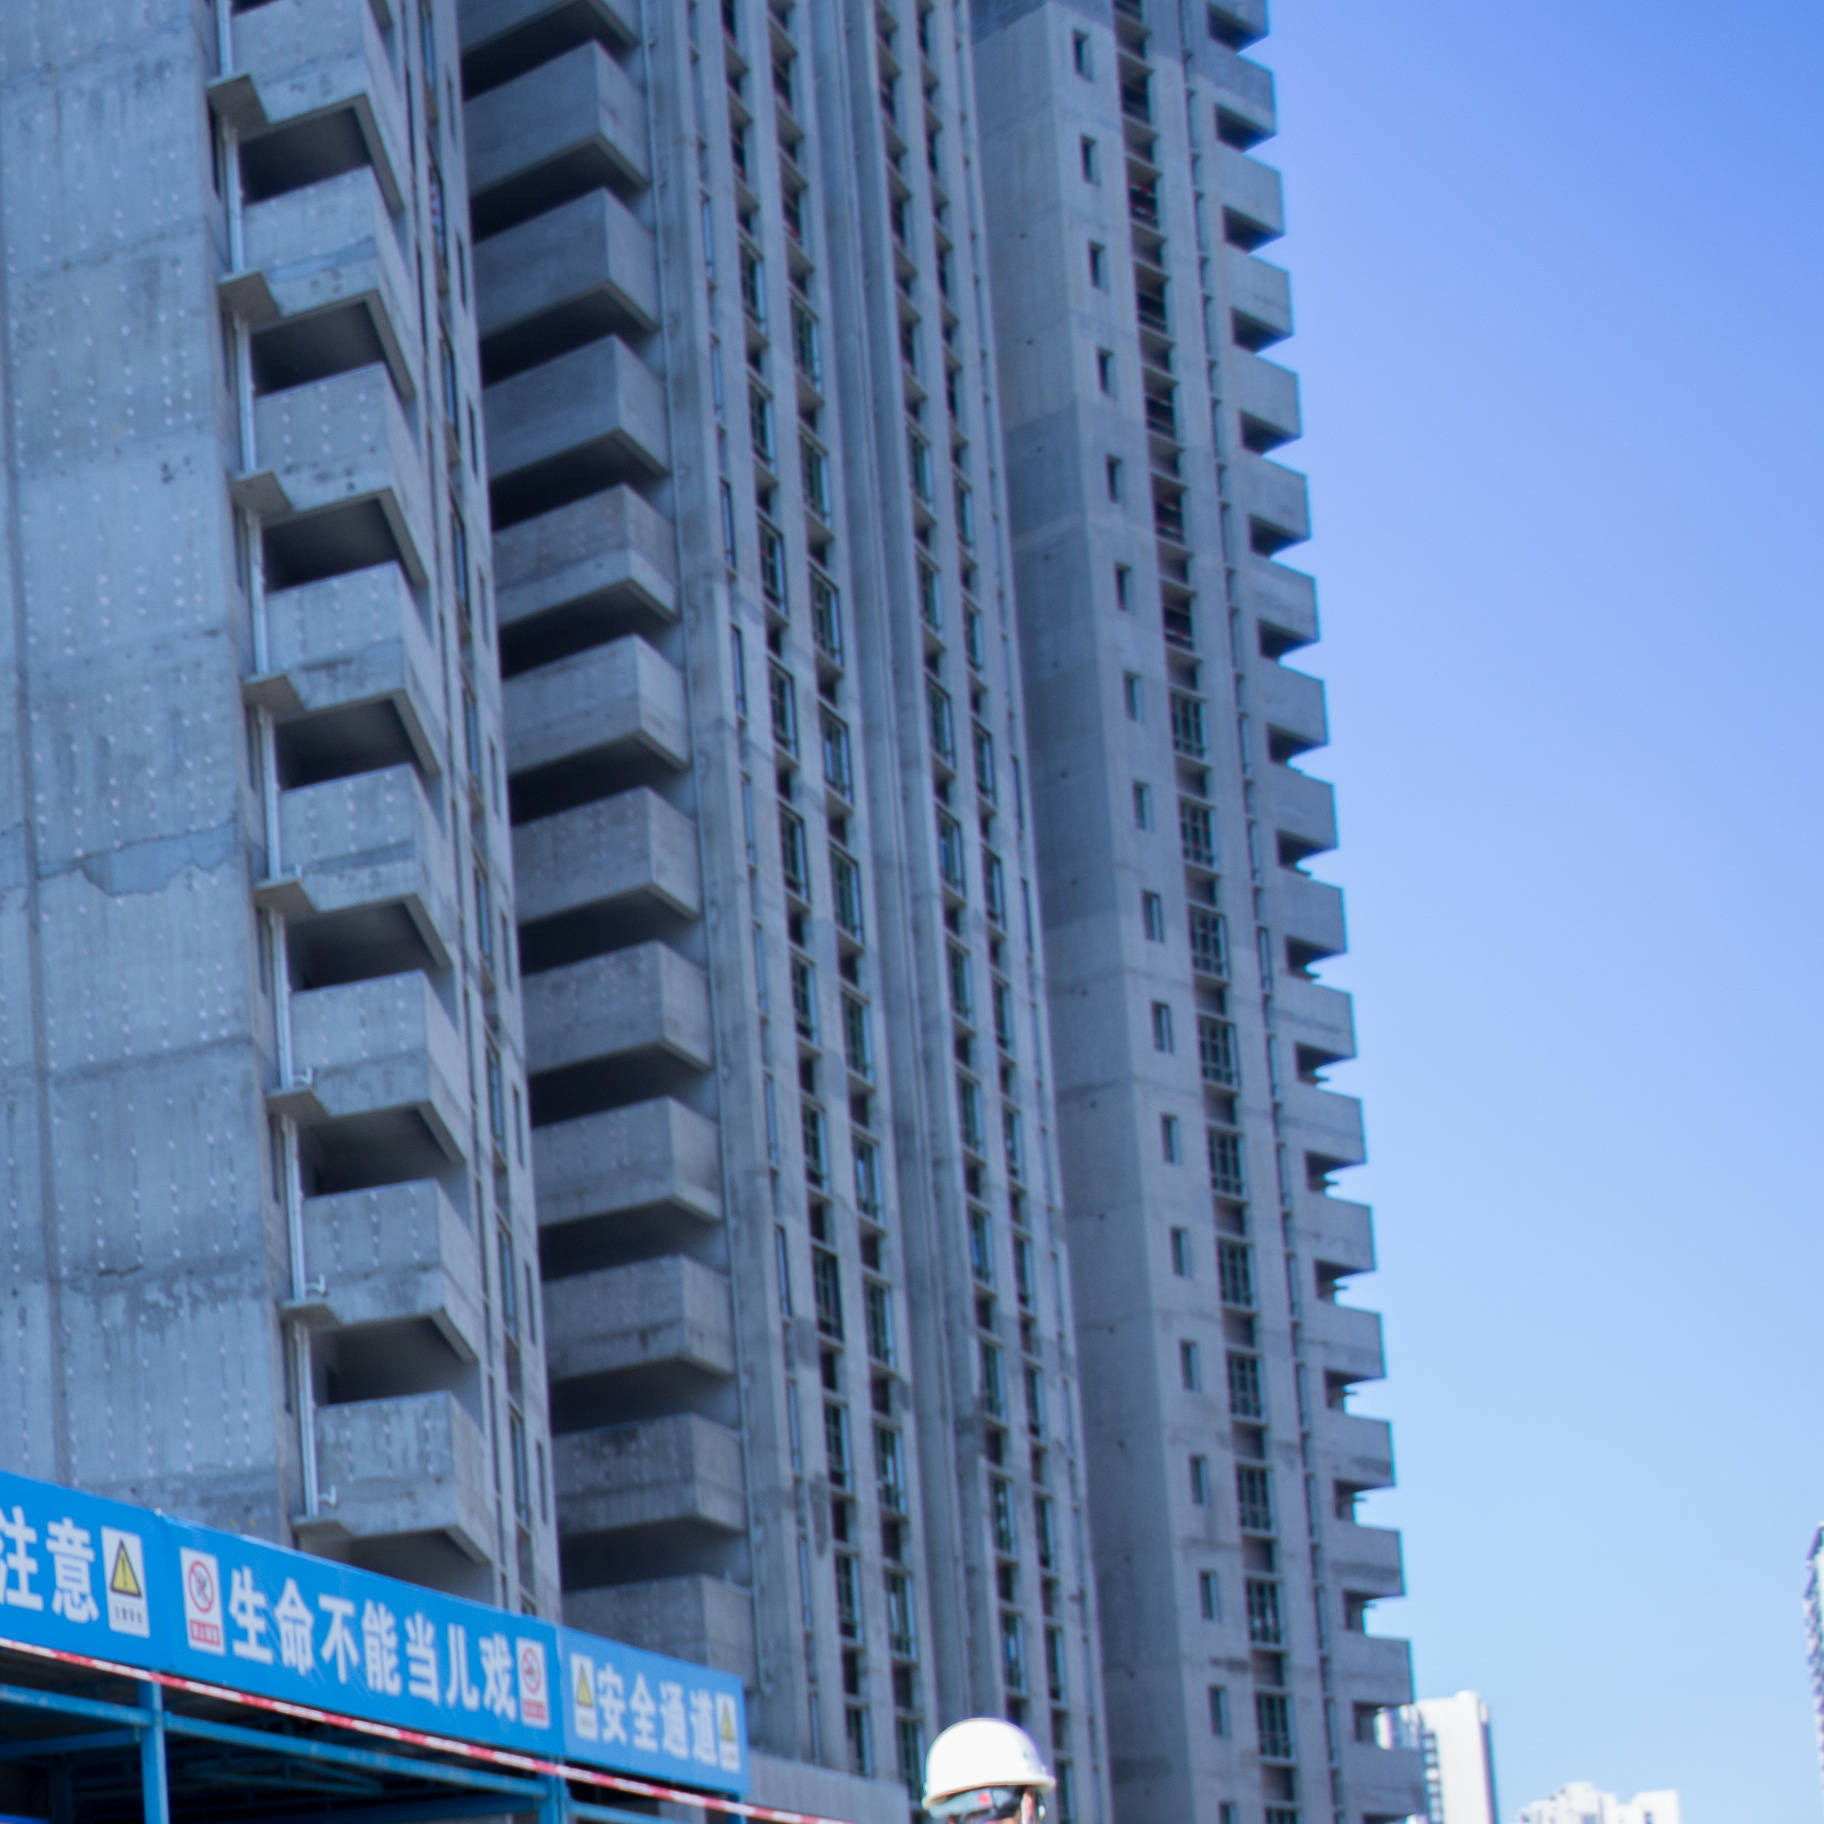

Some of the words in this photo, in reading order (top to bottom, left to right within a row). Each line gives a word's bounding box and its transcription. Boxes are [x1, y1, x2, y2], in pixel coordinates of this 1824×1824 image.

[228, 1565, 518, 1724] 生命不能当儿戏
[596, 1662, 719, 1767] 安全通道
